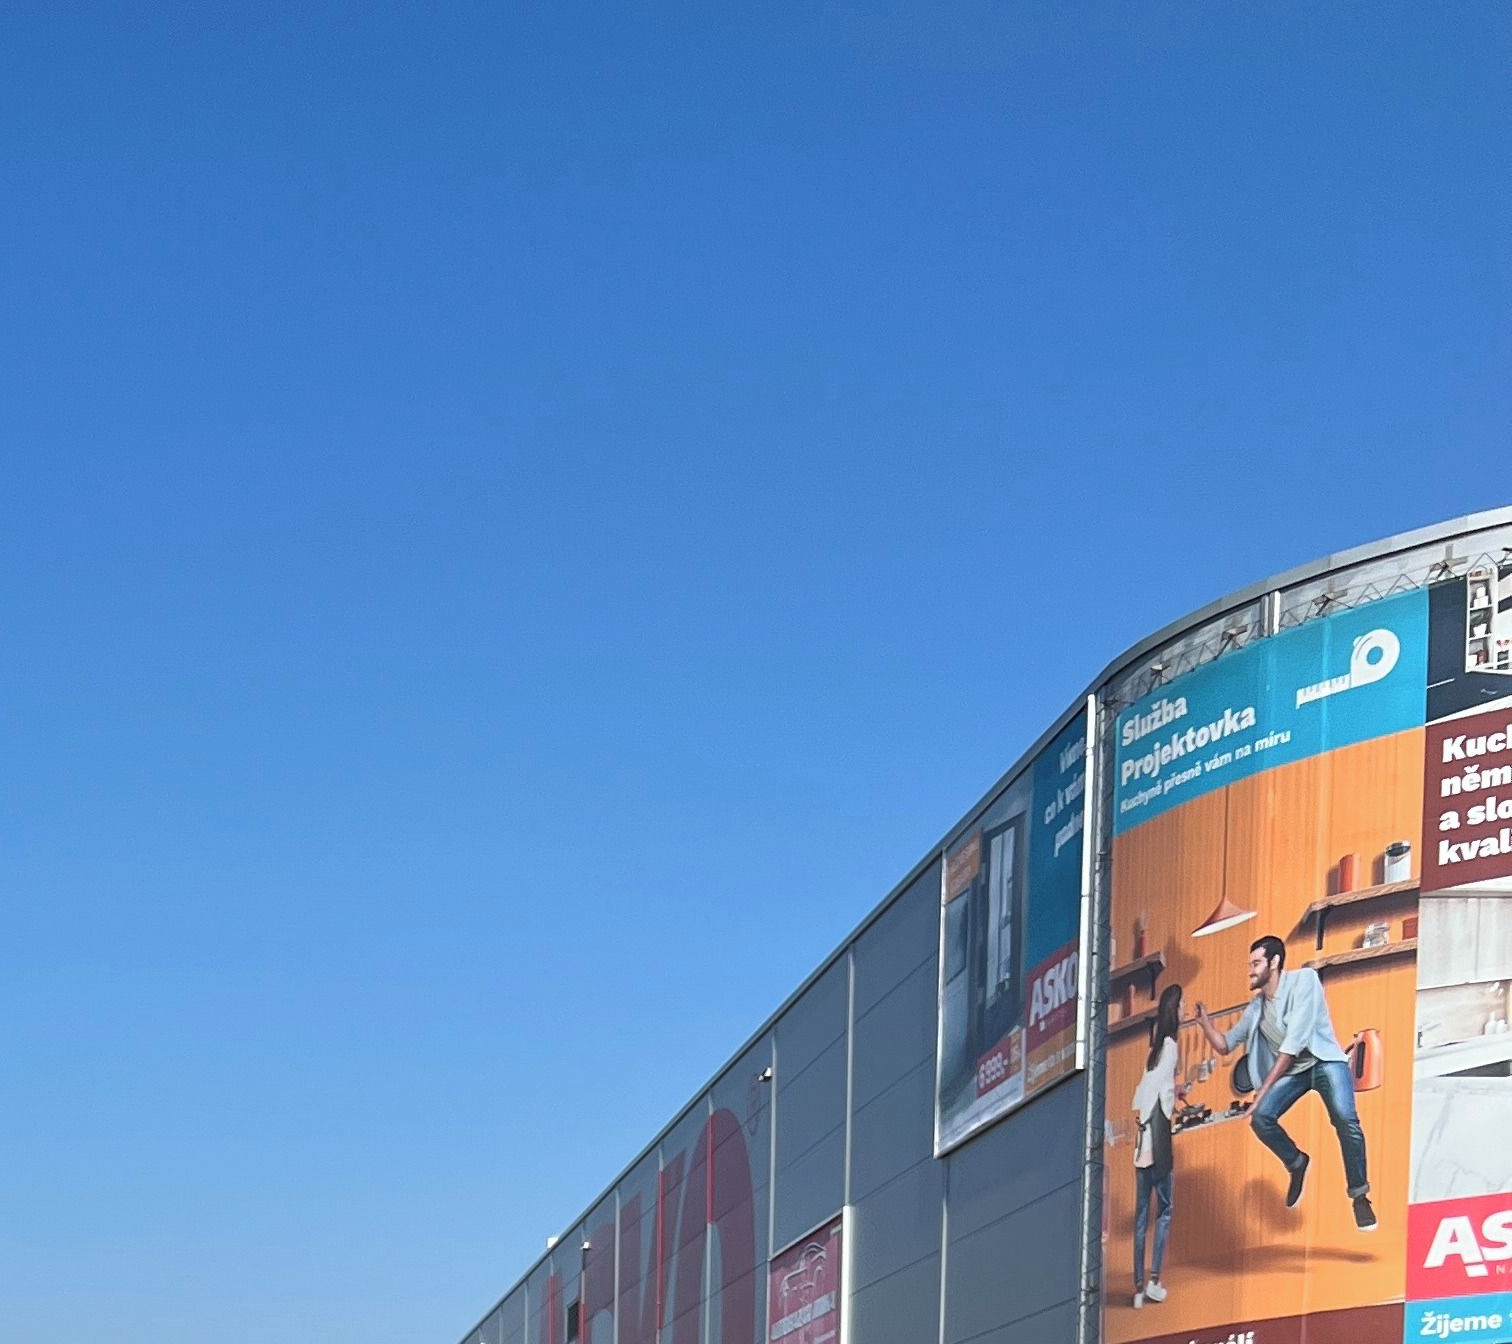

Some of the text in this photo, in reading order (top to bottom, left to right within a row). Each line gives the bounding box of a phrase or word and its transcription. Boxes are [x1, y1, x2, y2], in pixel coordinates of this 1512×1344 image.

[1120, 706, 1256, 786] Projektovka
[1121, 697, 1188, 746] Služba
[1442, 723, 1512, 763] Kuc
[1120, 730, 1291, 813] Kuchyně přesně vám na míru
[1439, 811, 1460, 831] a
[1029, 952, 1079, 1032] ASKO
[1420, 1311, 1503, 1339] Žijeme
